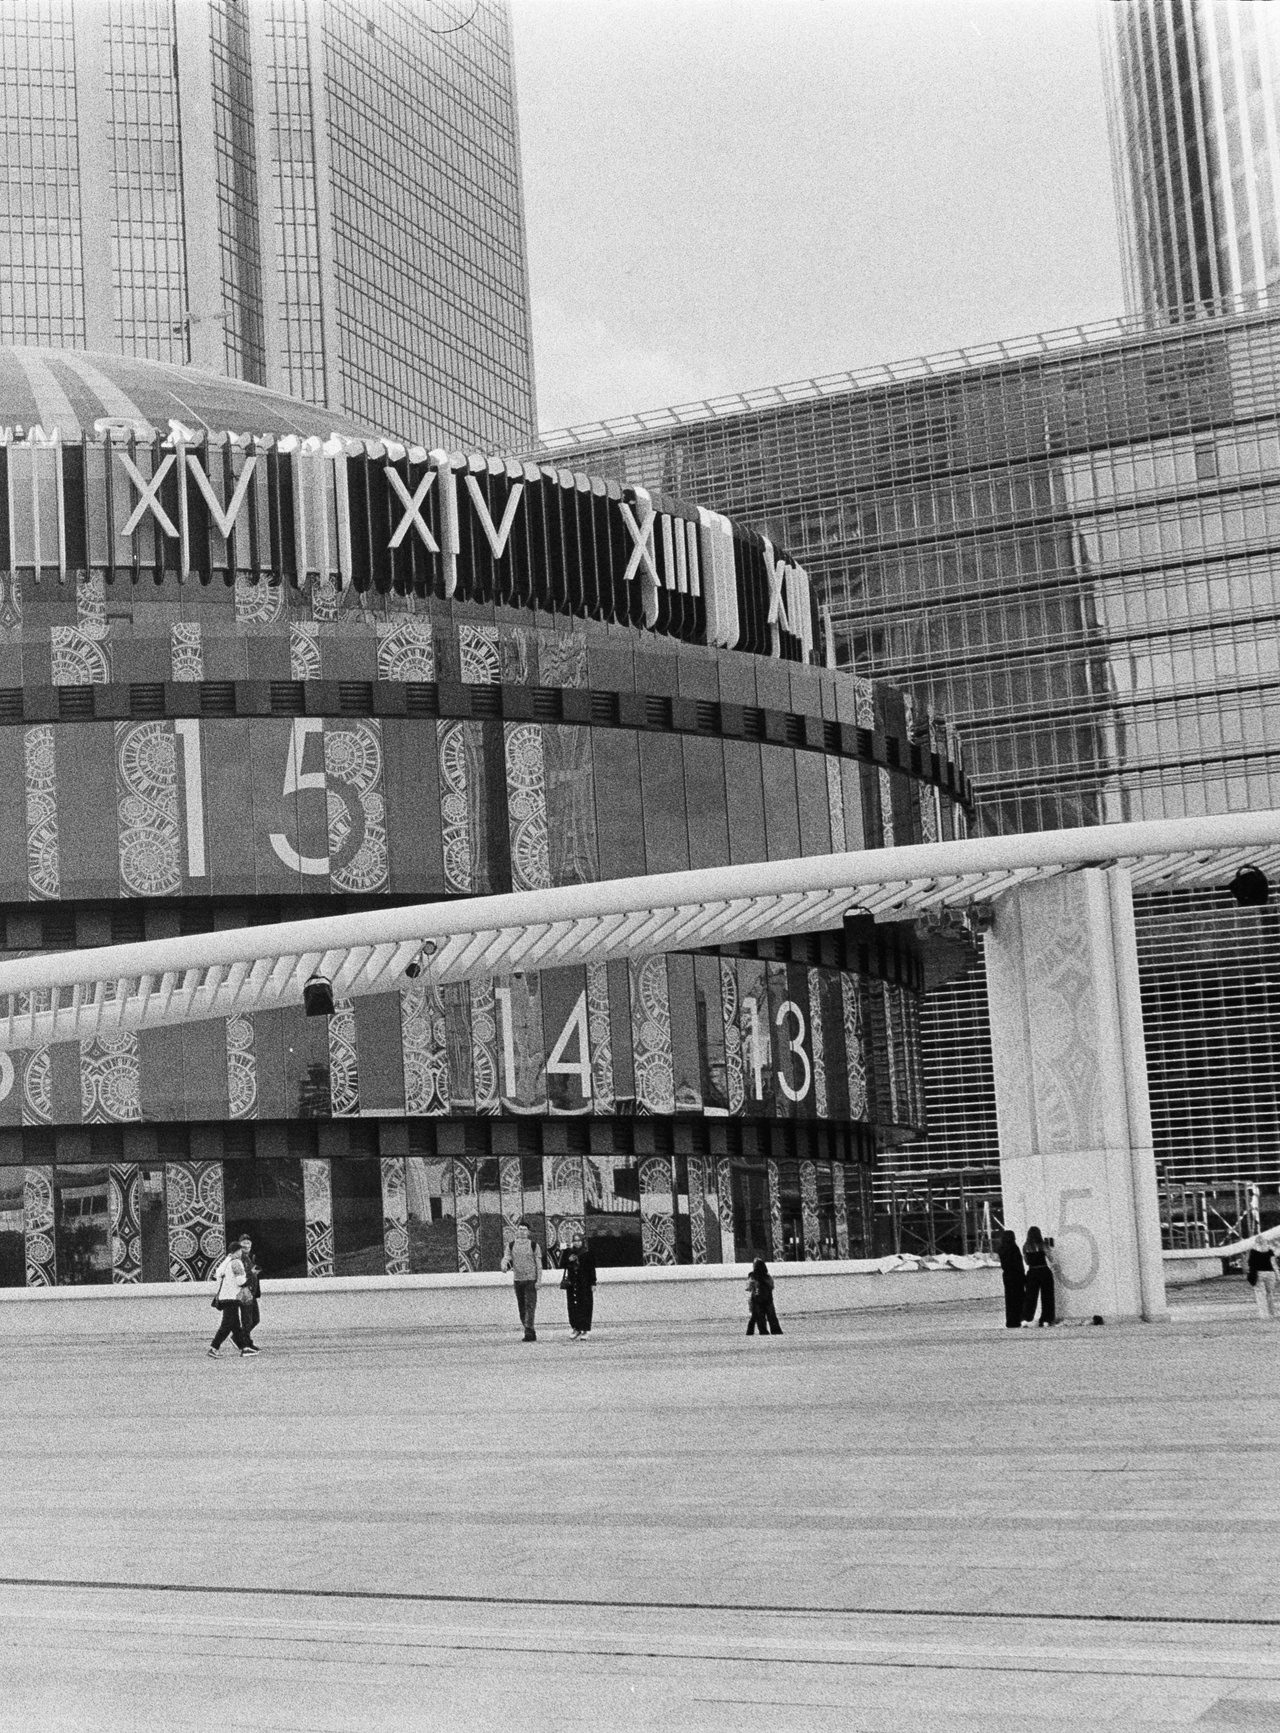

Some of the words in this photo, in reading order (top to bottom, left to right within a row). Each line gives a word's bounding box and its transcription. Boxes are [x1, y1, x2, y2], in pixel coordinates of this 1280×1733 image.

[118, 453, 257, 539] XV
[384, 466, 523, 559] XIV
[618, 502, 701, 597] XIII
[175, 719, 366, 877] 15
[495, 987, 592, 1097] 14
[743, 997, 811, 1101] 13
